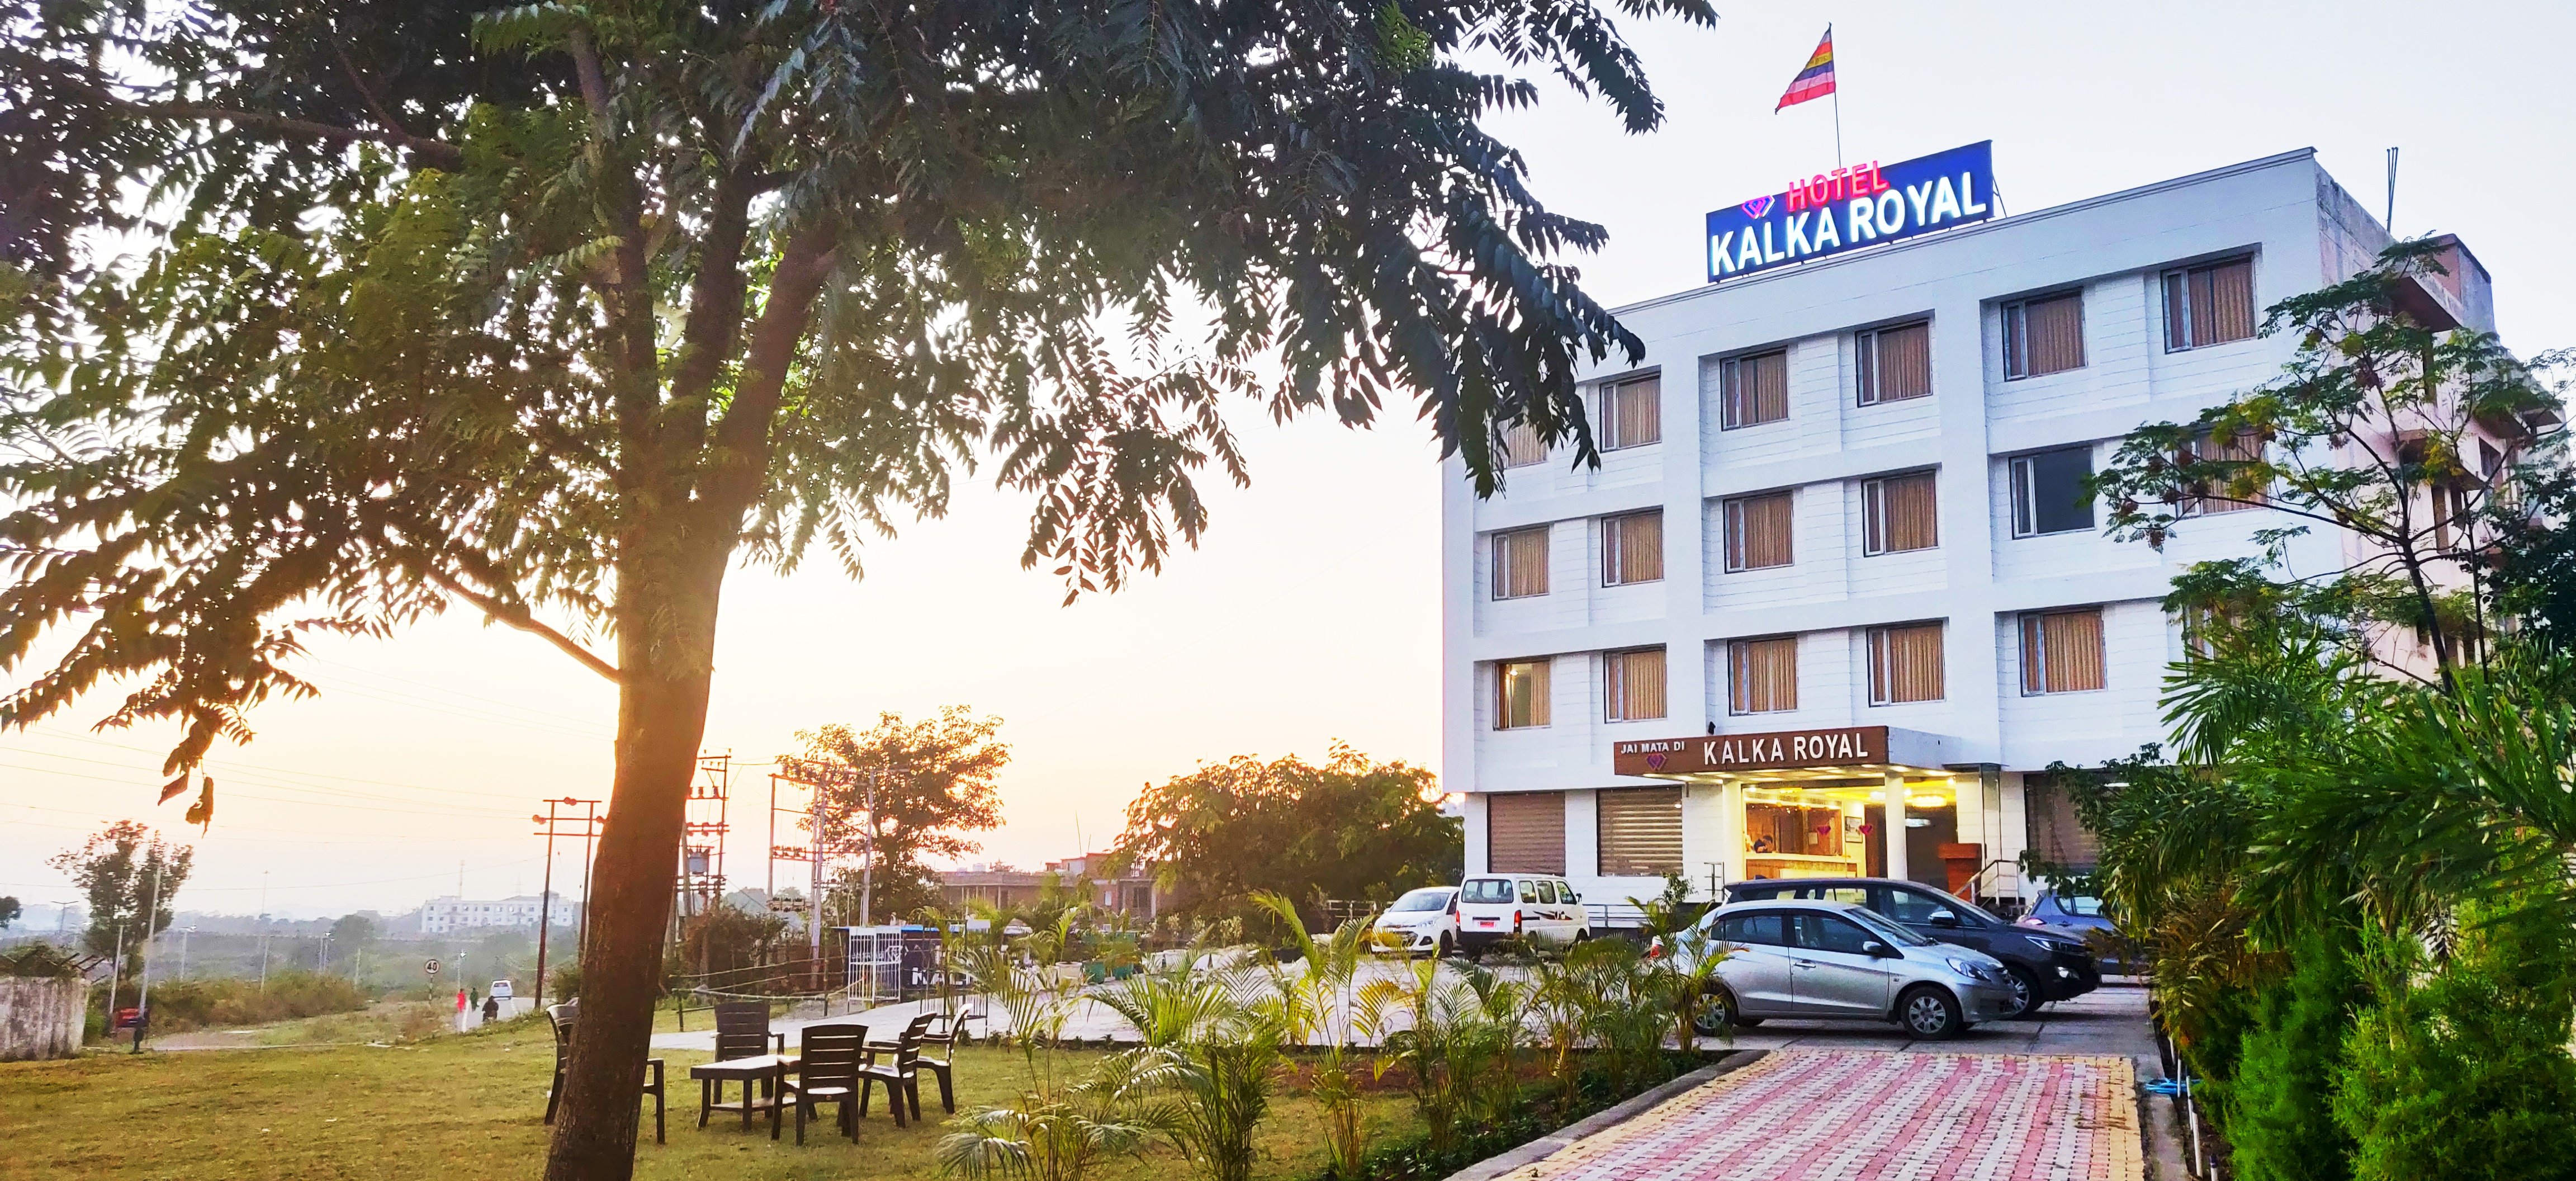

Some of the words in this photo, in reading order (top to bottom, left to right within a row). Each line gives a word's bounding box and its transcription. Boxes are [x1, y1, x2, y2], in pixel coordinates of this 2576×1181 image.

[1788, 160, 1890, 212] HOTEL
[1712, 206, 1840, 276] KALKA
[1849, 172, 1987, 243] ROYAL
[1621, 744, 1637, 754] JAI
[1641, 742, 1669, 753] MATA
[1674, 741, 1685, 751] DI
[1704, 738, 1785, 766] KALKA
[1794, 733, 1869, 761] ROYAL
[427, 962, 437, 971] 40
